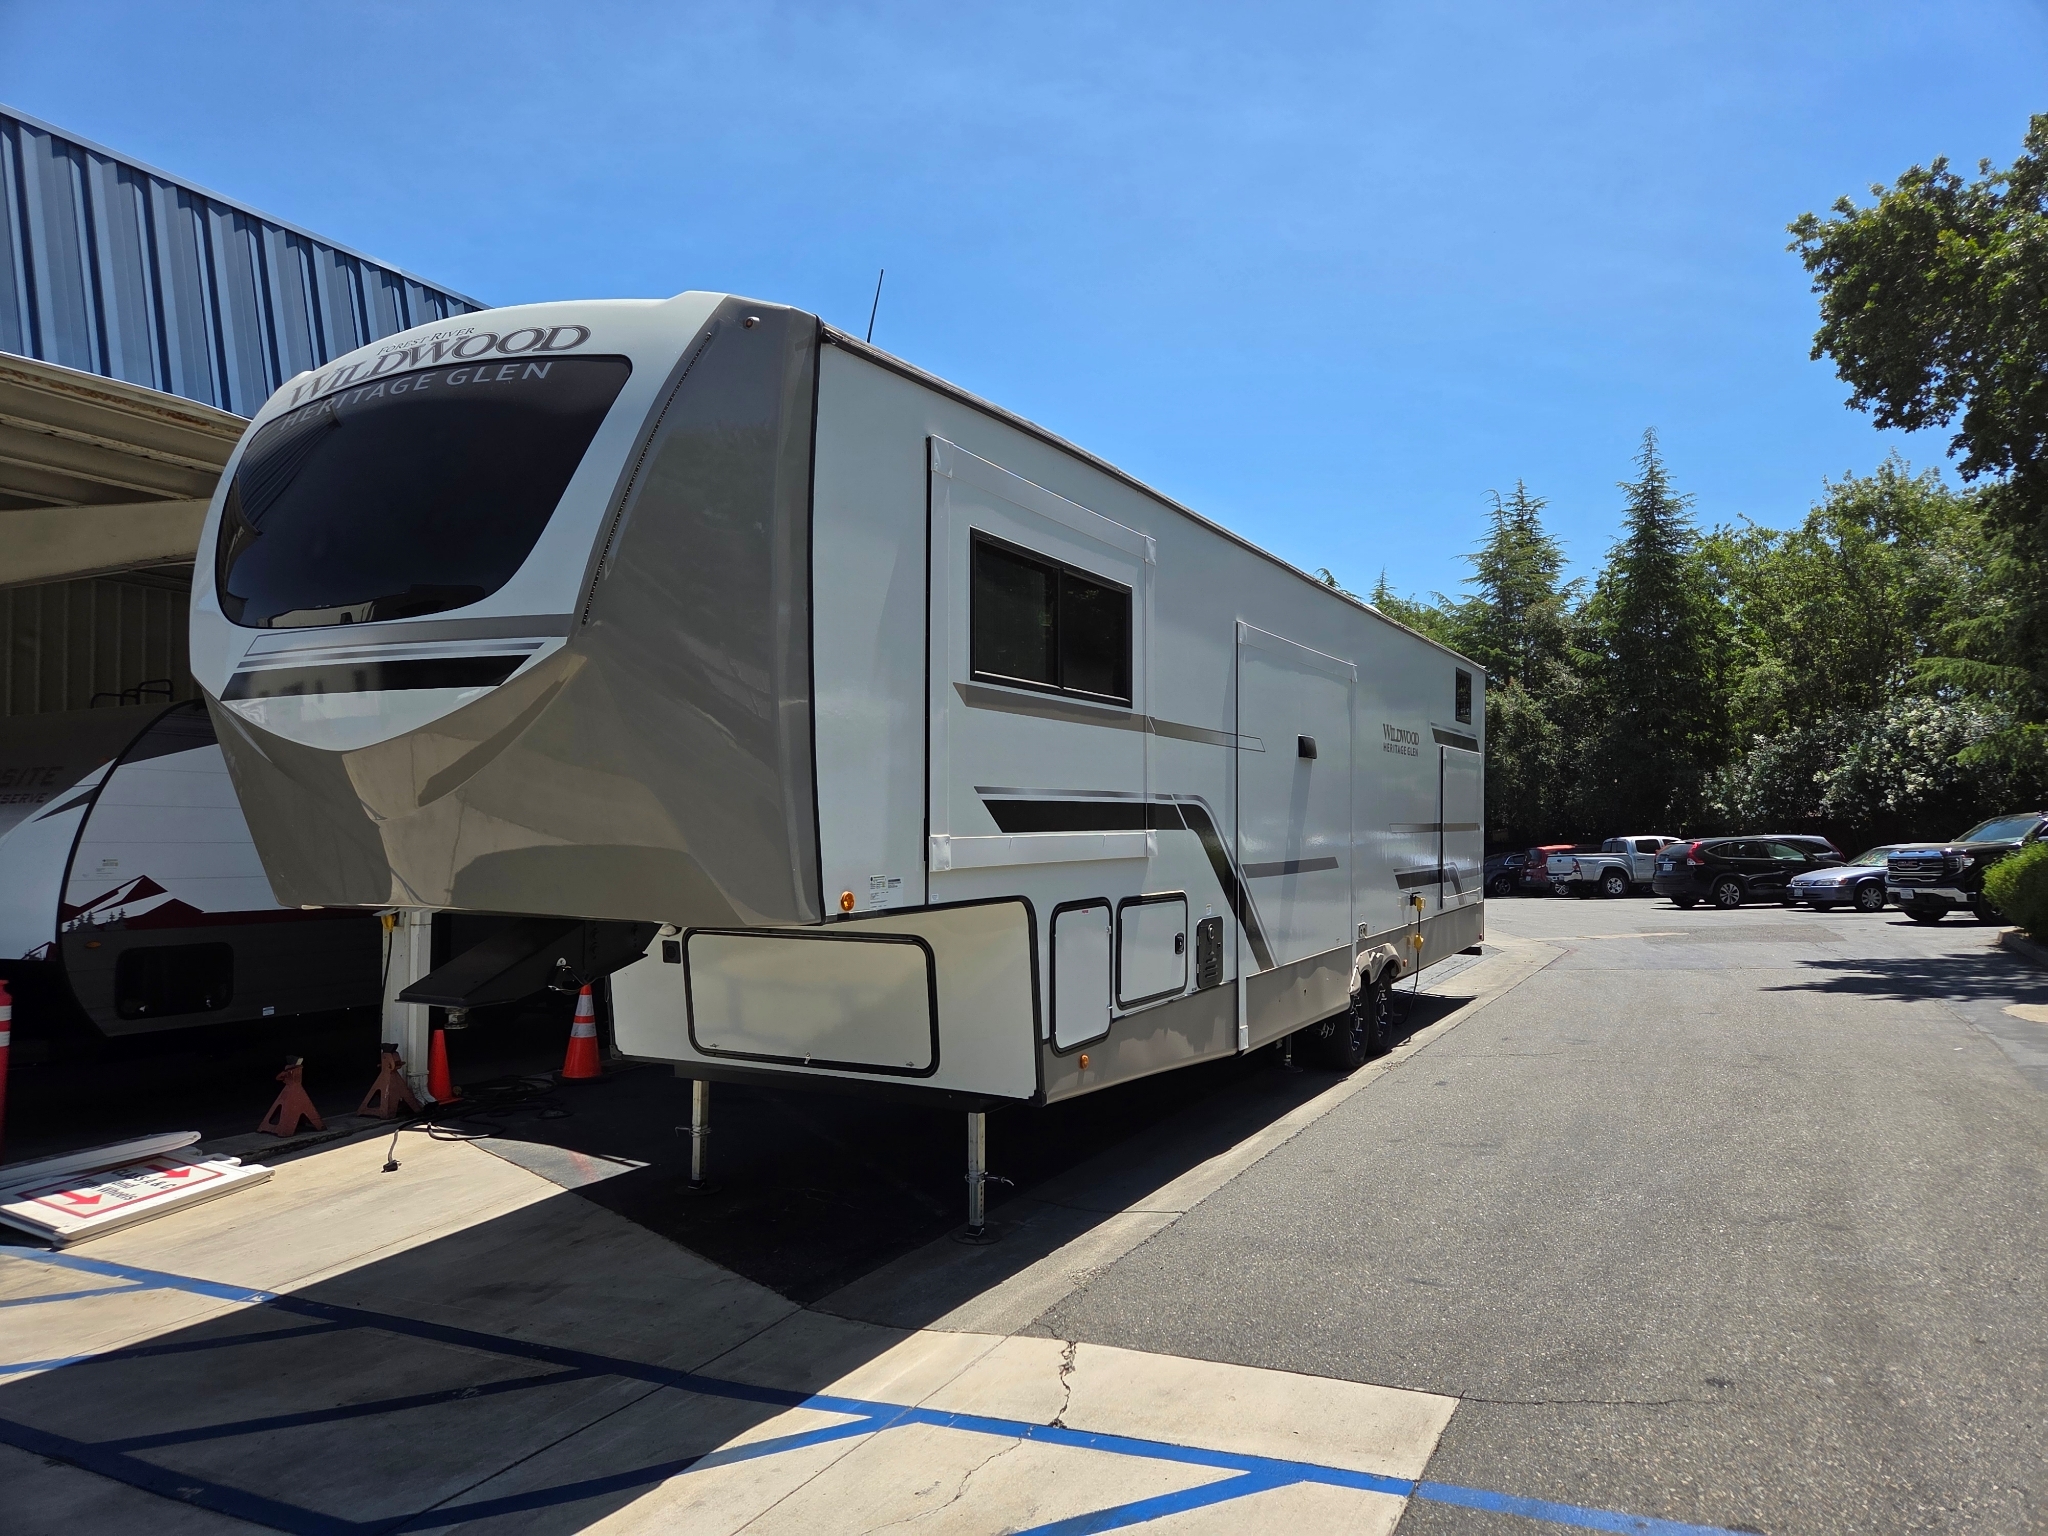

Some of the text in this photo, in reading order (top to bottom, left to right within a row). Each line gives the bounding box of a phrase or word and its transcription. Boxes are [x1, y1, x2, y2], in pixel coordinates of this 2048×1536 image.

[377, 327, 475, 355] FOREST RIVER
[288, 324, 591, 408] WILDWOOD
[279, 362, 553, 431] HERITAGE GLEN
[1382, 723, 1420, 746] WILDWOOD
[1382, 742, 1419, 757] HERITAGE GLEN
[0, 766, 64, 788] SITE
